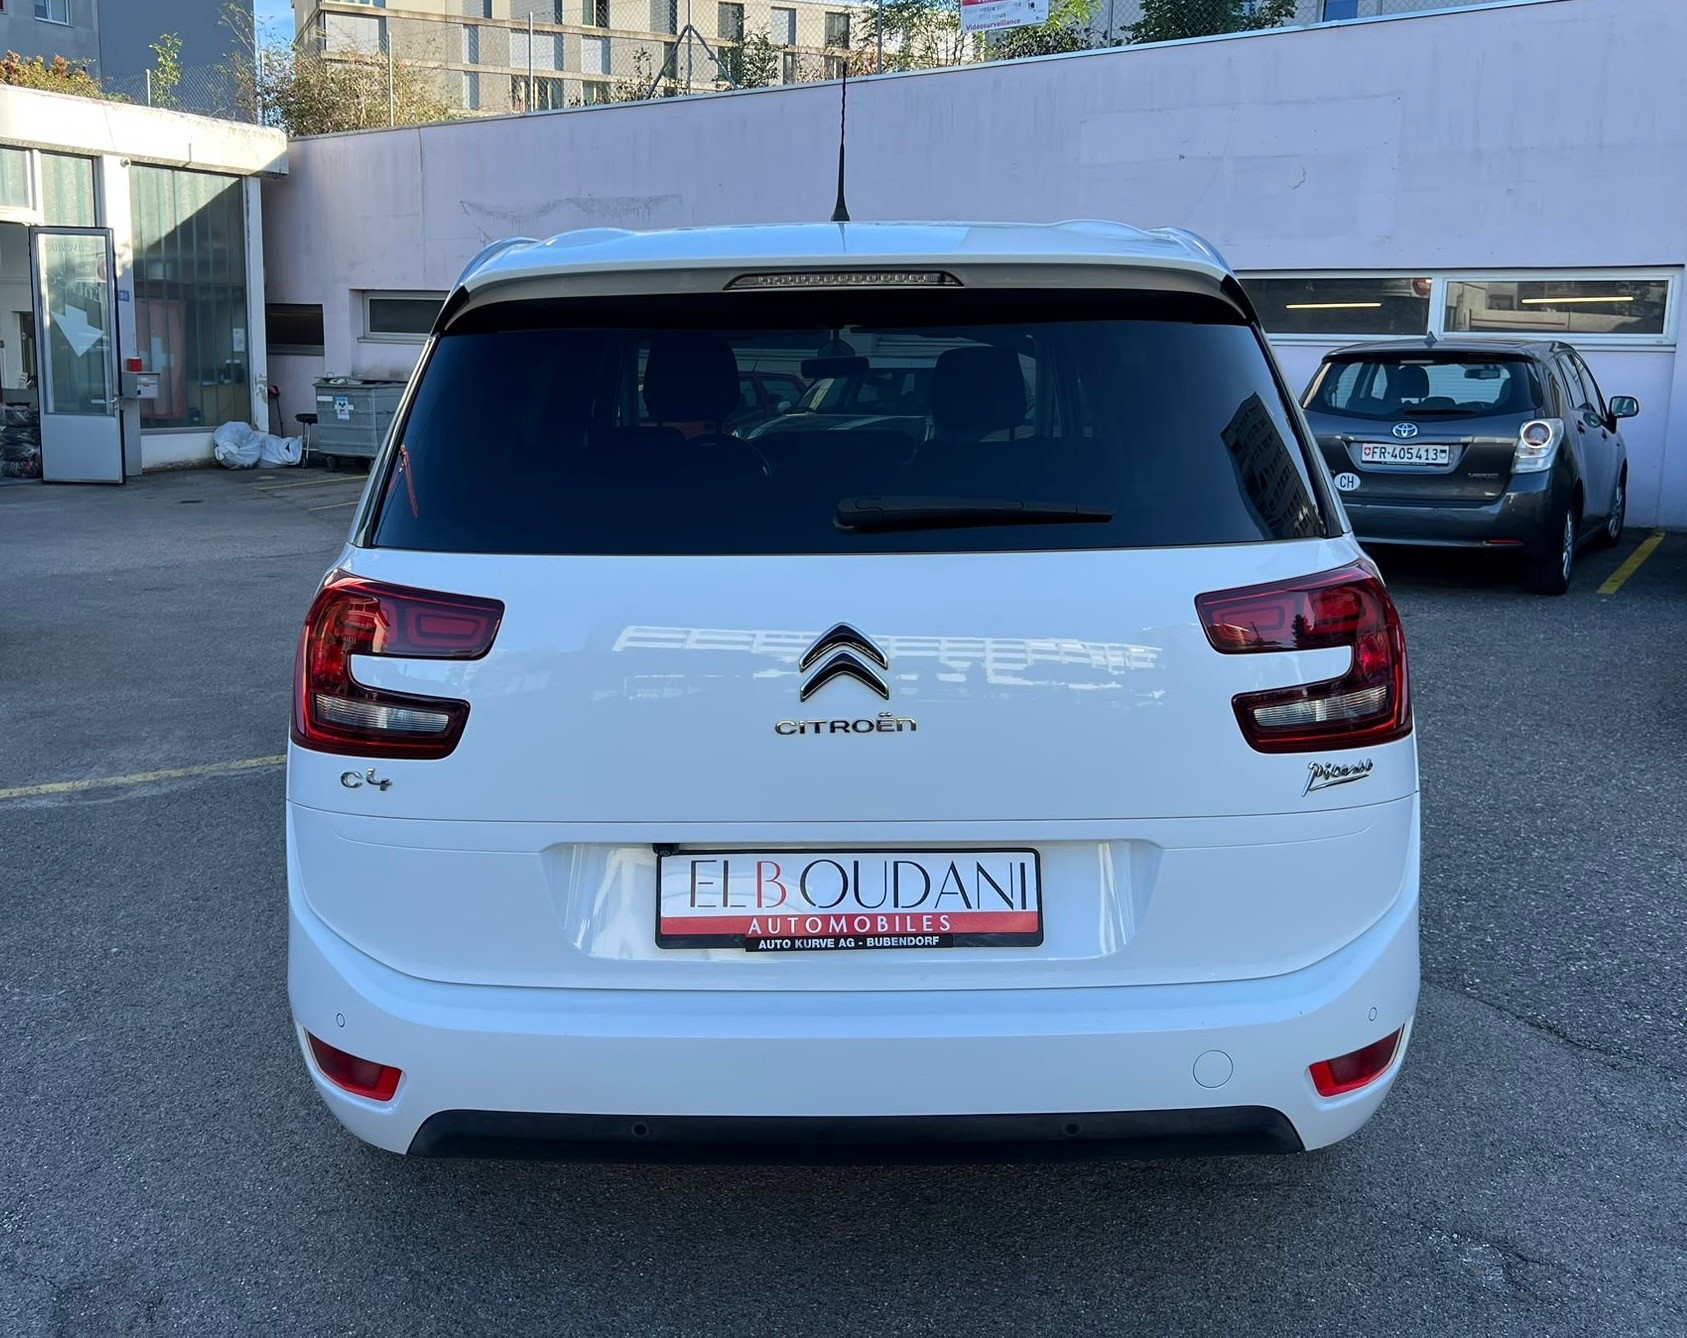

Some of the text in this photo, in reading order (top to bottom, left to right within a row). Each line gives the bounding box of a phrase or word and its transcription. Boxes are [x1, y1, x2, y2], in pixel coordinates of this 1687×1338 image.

[965, 18, 1021, 31] Vidéosurveillance
[1339, 474, 1354, 489] CH
[340, 767, 393, 791] C4
[748, 914, 952, 936] AUTOMOBILES
[758, 938, 792, 949] AUTO
[794, 937, 836, 949] KURVE
[838, 937, 855, 948] AG
[867, 936, 940, 948] BUBENDORF
